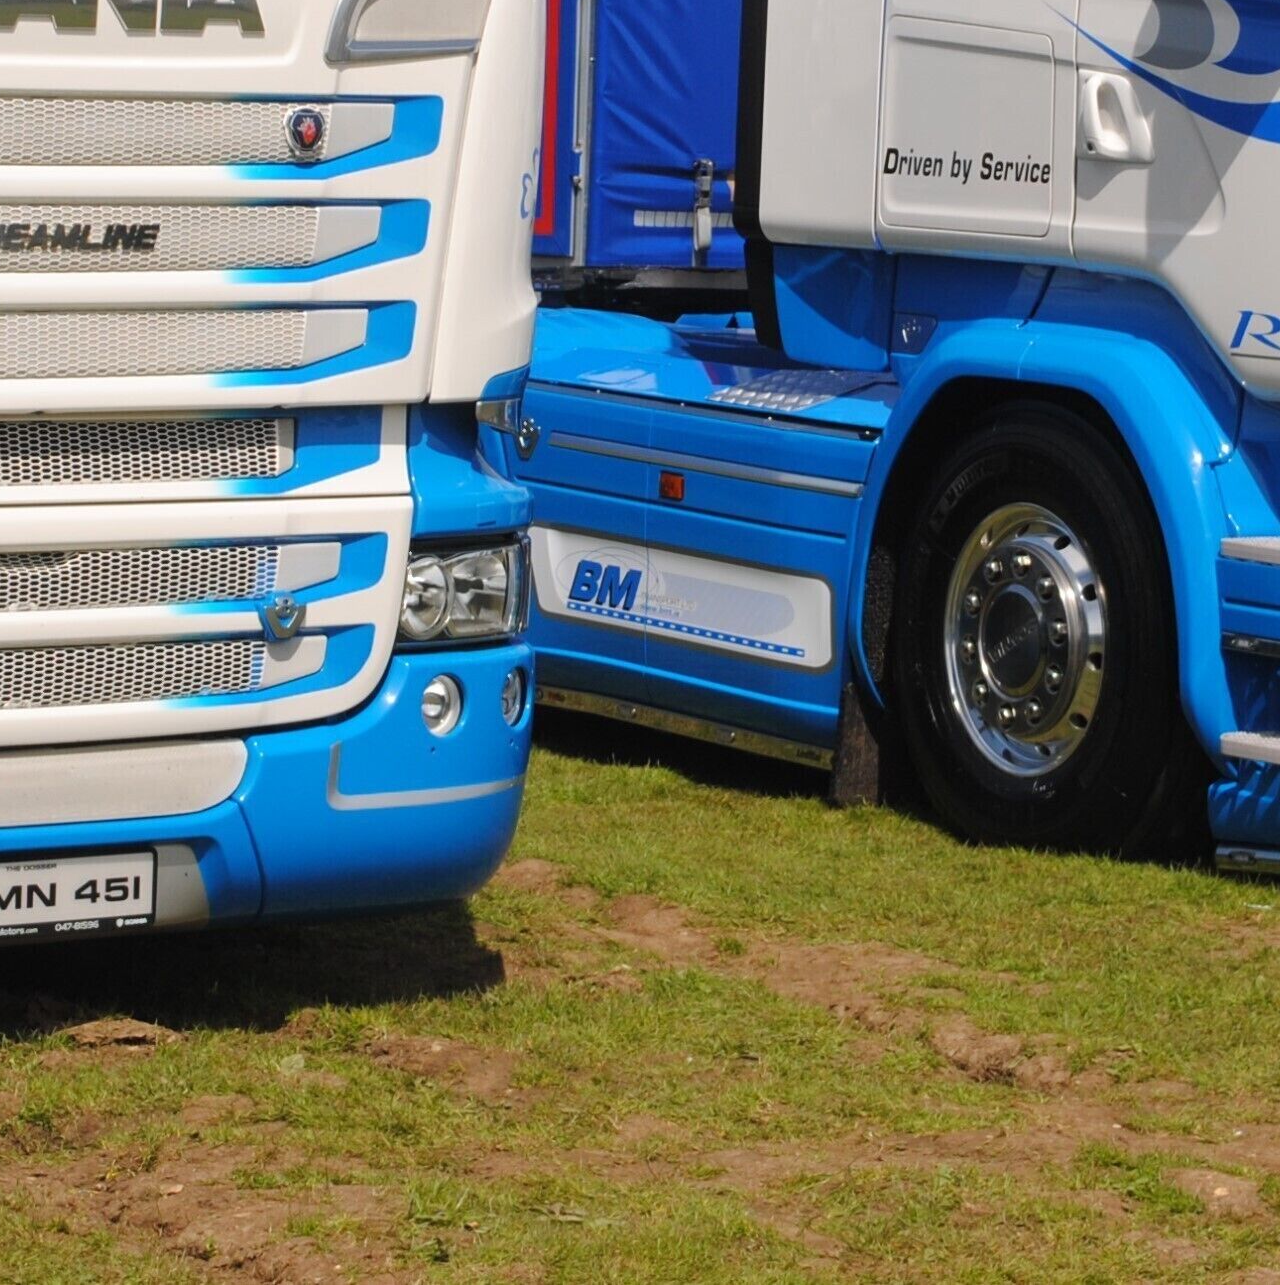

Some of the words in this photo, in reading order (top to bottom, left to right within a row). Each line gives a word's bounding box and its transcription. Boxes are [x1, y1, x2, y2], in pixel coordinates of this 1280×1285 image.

[883, 147, 943, 178] Driven
[950, 151, 971, 184] by
[980, 152, 1051, 183] Service
[569, 559, 642, 611] BM
[75, 876, 140, 903] 451
